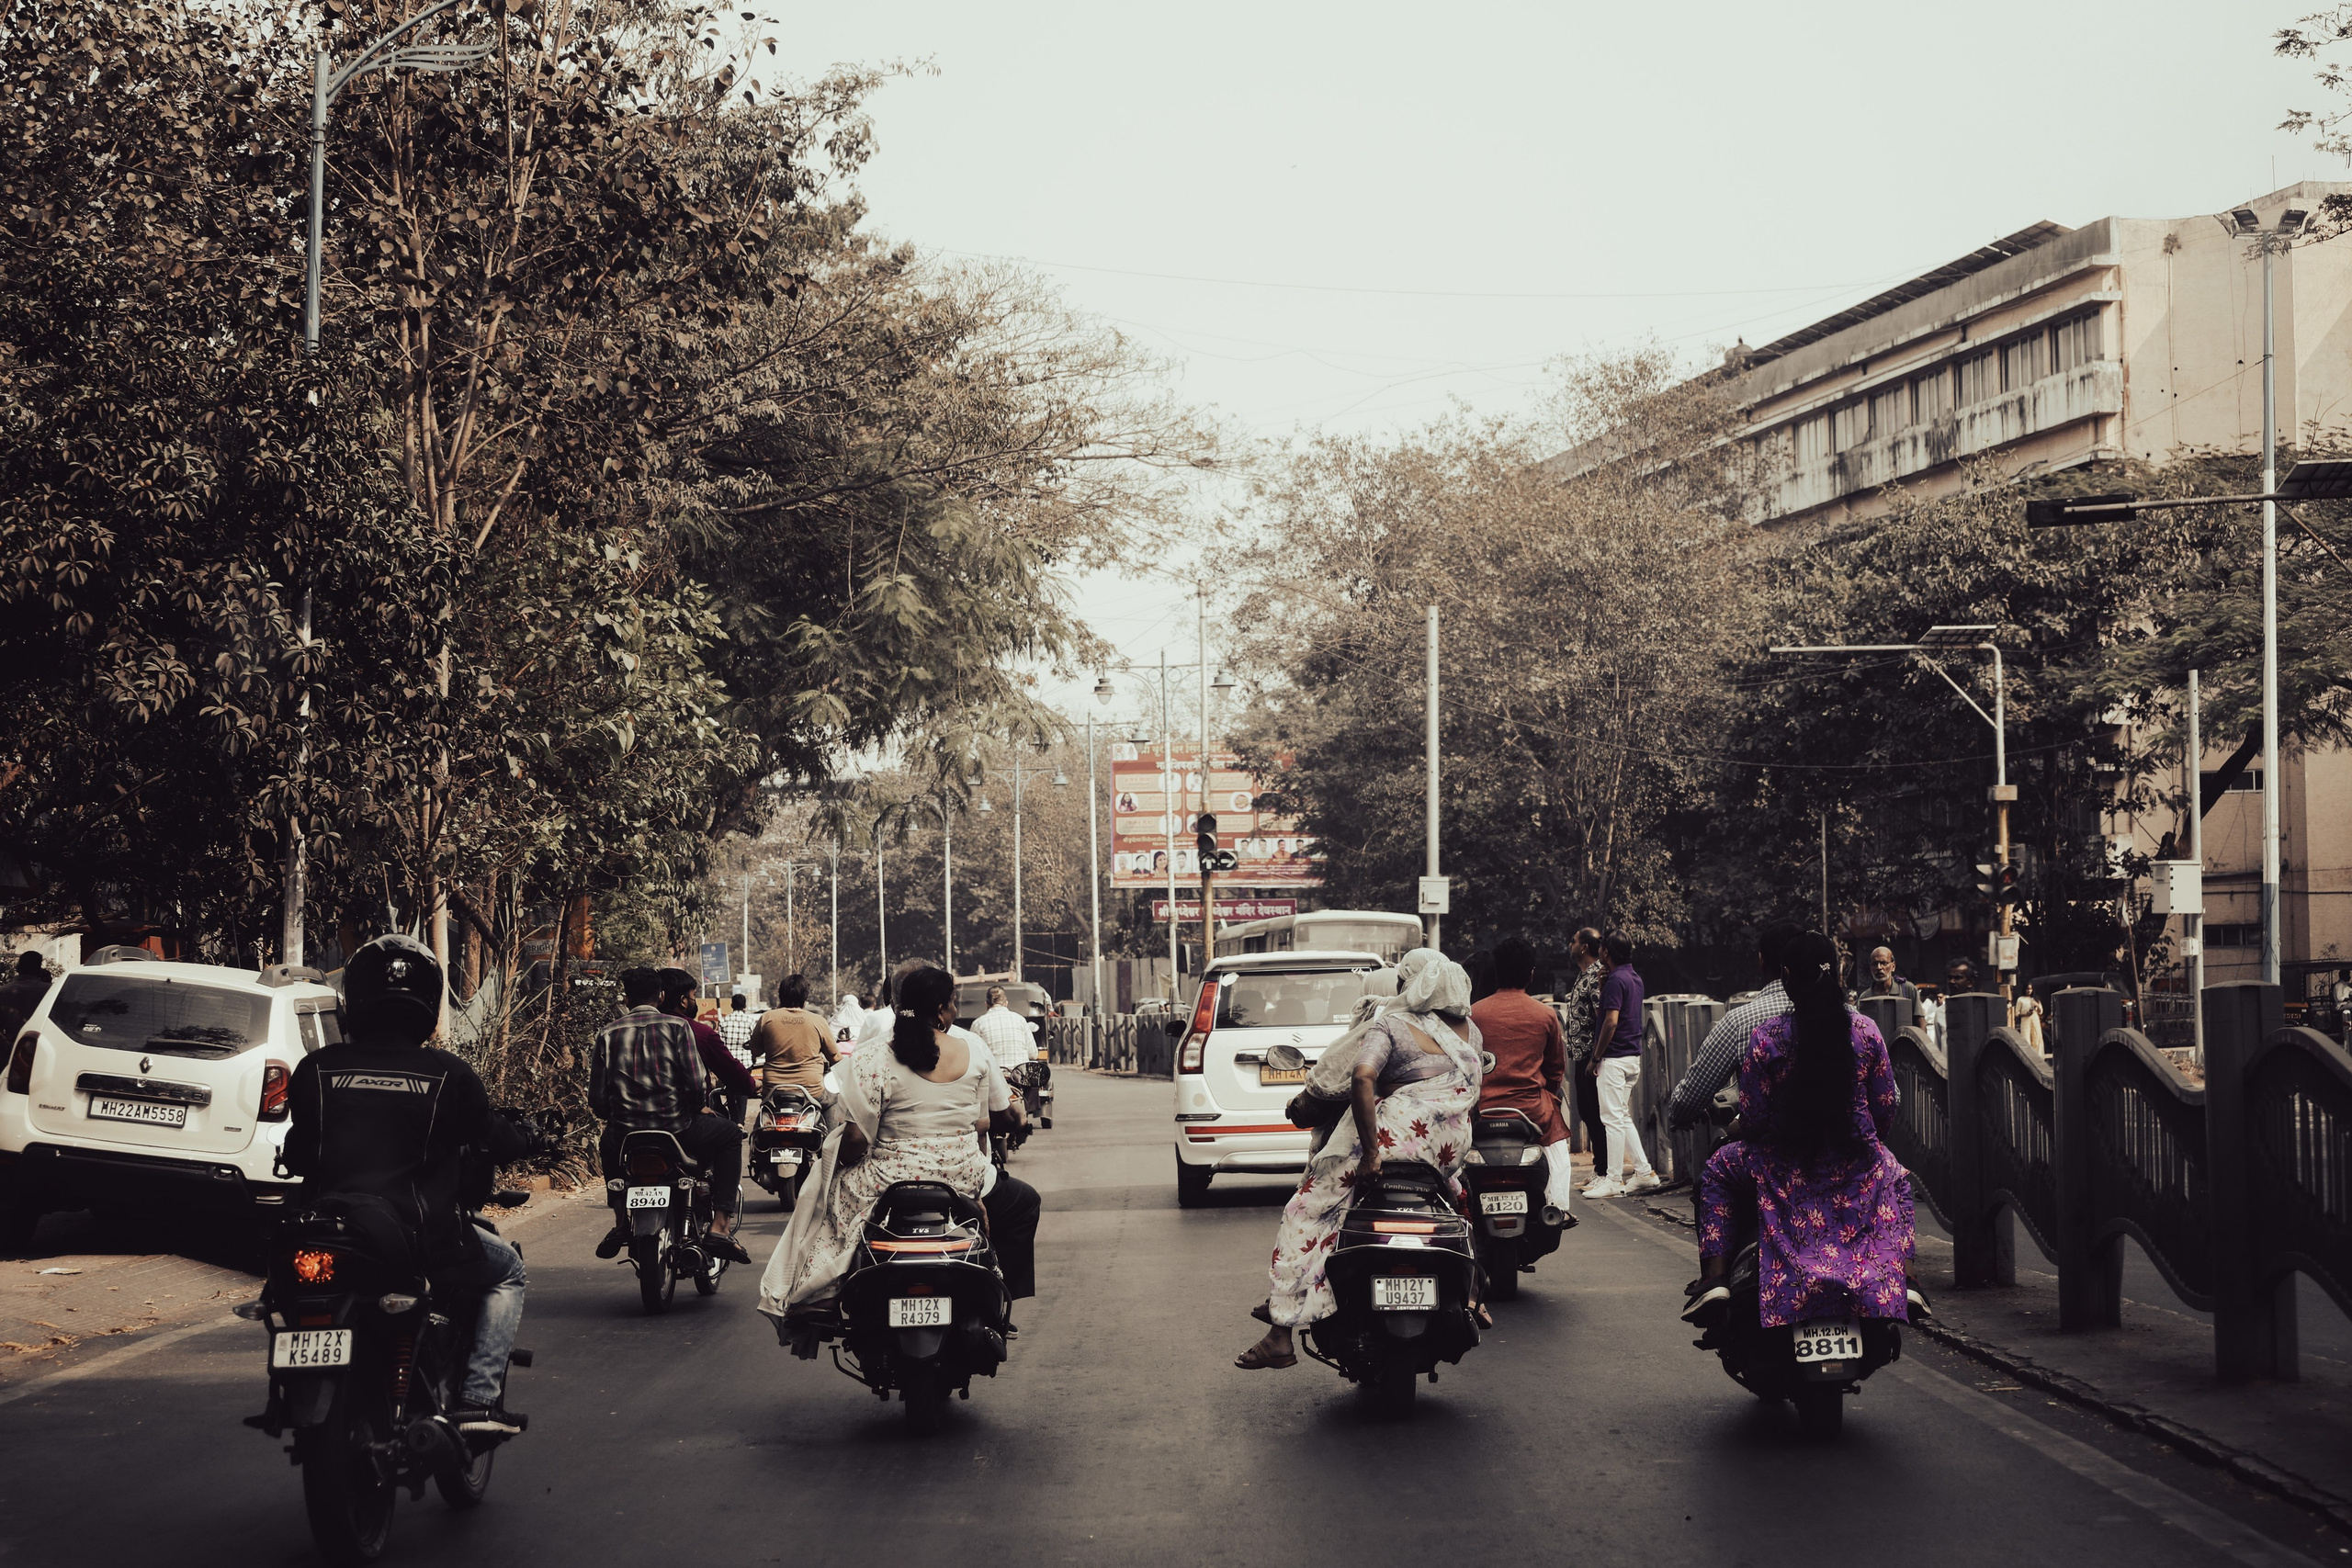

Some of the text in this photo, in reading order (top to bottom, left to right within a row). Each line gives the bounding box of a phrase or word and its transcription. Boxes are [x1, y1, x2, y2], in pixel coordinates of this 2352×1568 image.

[1235, 902, 1256, 917] मंदिर
[1257, 902, 1292, 917] देवस्थान
[355, 1078, 404, 1088] AXOR
[101, 1100, 184, 1123] MH22AM5558
[630, 1197, 667, 1207] 8940
[1485, 1201, 1523, 1213] 4120
[1385, 1279, 1424, 1292] MH12Y
[1385, 1292, 1425, 1304] U9437
[901, 1299, 939, 1312] MH12X
[901, 1312, 940, 1325] R4379
[1803, 1326, 1849, 1338] MH.12.DH
[291, 1331, 344, 1348] MH12X
[1796, 1337, 1858, 1357] 8811
[289, 1348, 342, 1365] K5489
